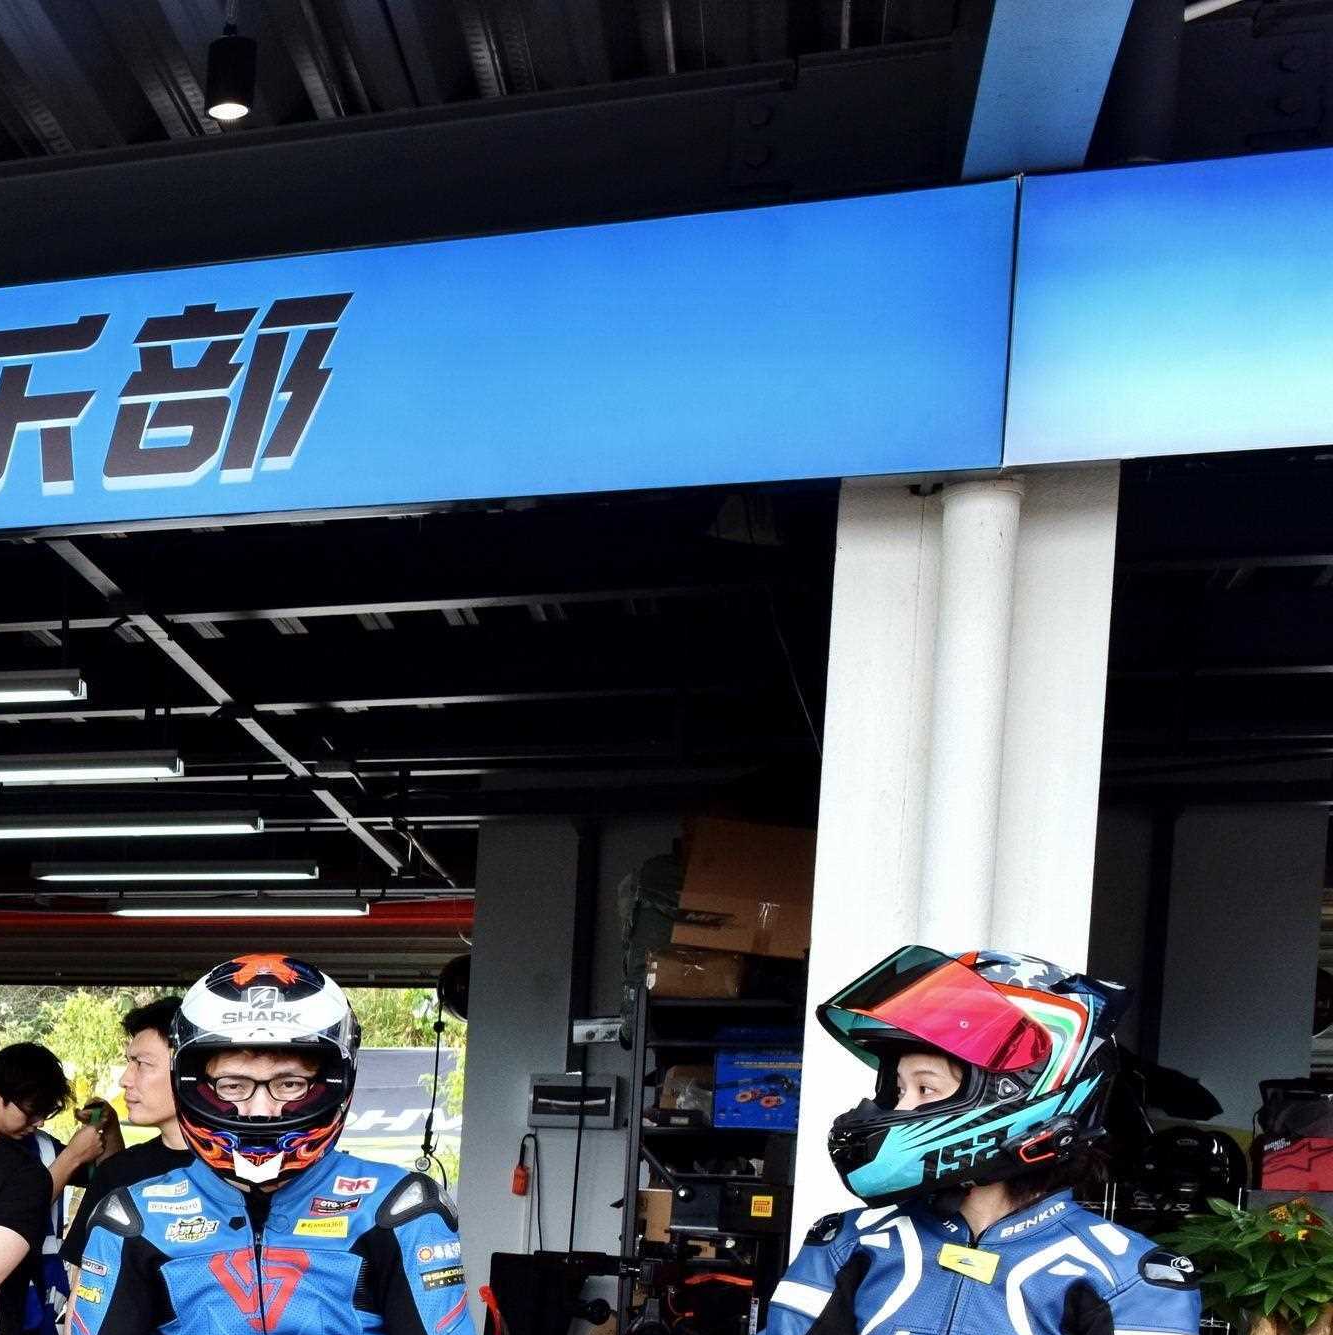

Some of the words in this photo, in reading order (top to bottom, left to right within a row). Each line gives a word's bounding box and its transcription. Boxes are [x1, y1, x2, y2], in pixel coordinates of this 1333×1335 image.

[221, 1010, 302, 1025] SHARK
[337, 1178, 371, 1192] RK
[1000, 1200, 1066, 1239] BENKIA
